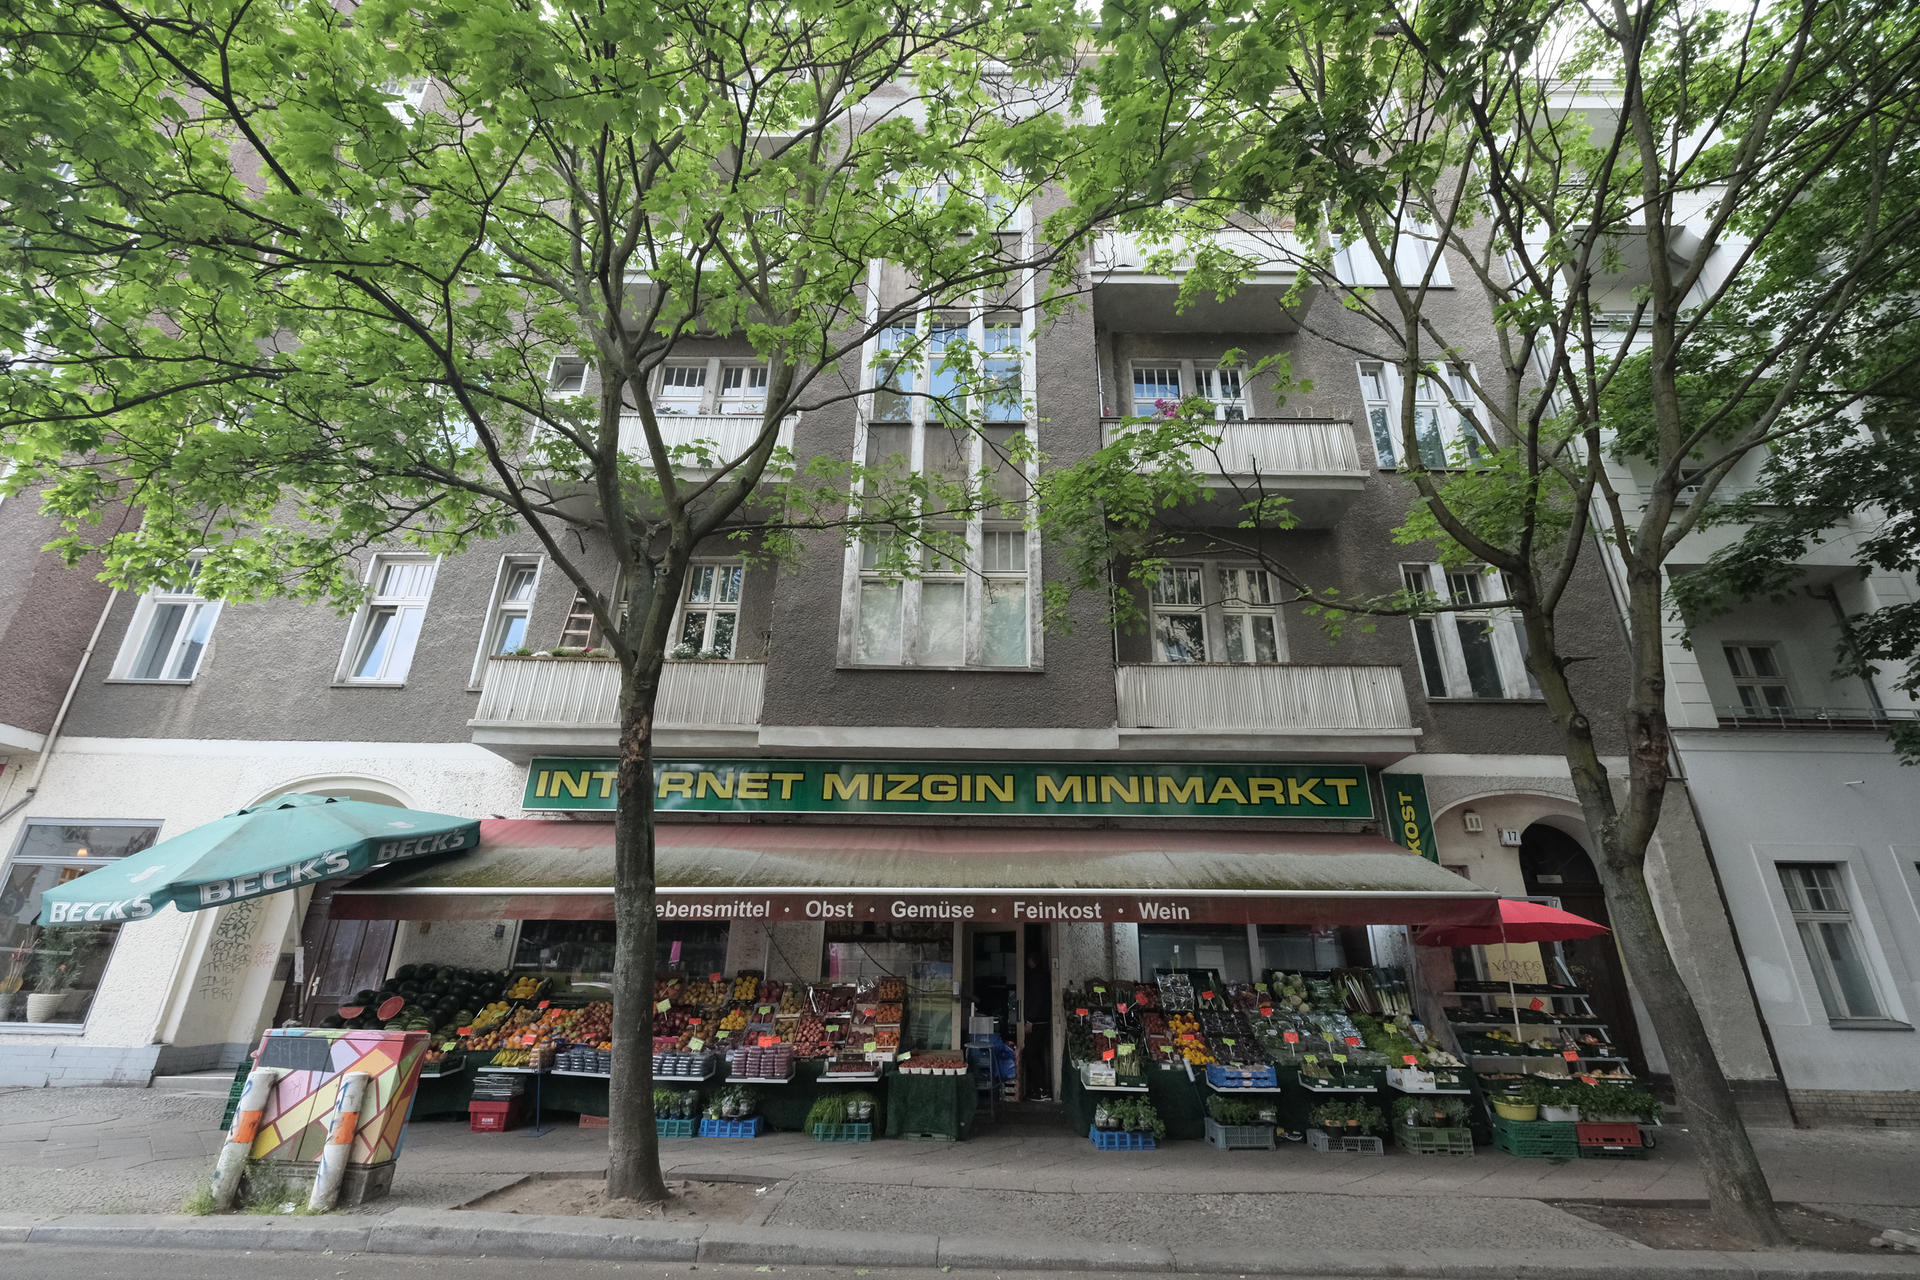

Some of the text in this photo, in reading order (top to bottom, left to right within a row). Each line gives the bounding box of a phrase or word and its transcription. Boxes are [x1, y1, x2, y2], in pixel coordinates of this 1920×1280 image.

[534, 770, 1357, 806] INTRNET MIZGIN MINIMARKT
[1507, 831, 1517, 841] 17
[200, 849, 351, 904] BECK'S
[655, 900, 1191, 920] ebensmittel Obst Gemüse Feinkost Wein
